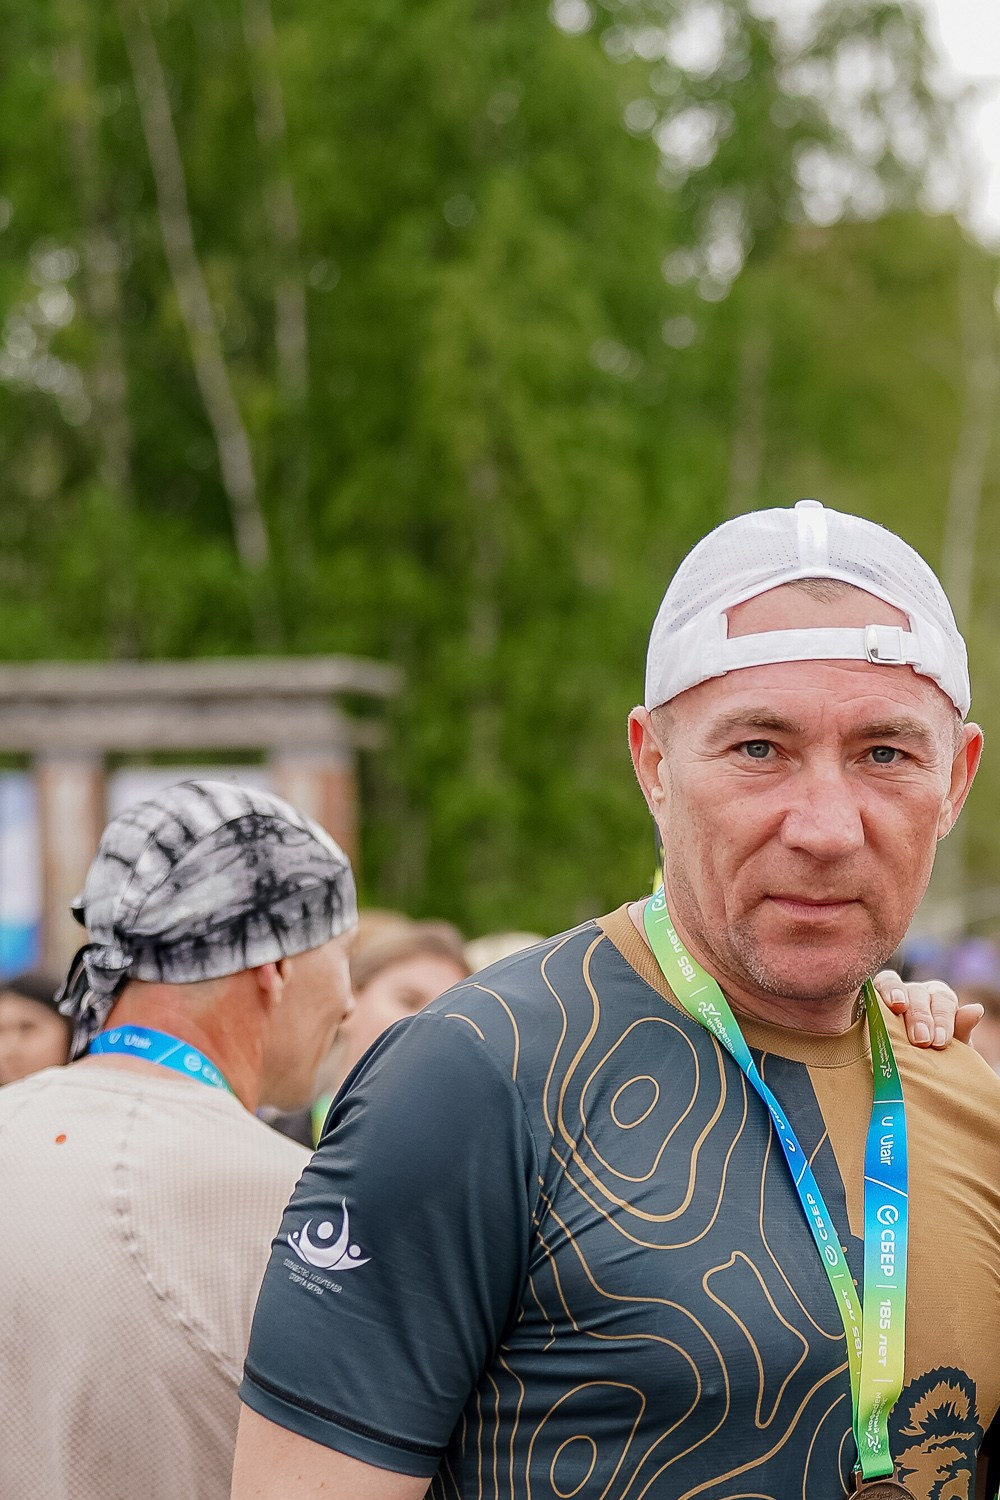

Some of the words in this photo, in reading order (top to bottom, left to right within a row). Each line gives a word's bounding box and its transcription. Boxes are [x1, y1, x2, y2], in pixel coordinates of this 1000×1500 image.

[677, 955, 697, 983] 185
[879, 1133, 894, 1166] Utair
[805, 1193, 828, 1240] СБЕР
[879, 1229, 896, 1277] СБЕР
[878, 1298, 892, 1331] 185
[876, 1333, 890, 1368] лет
